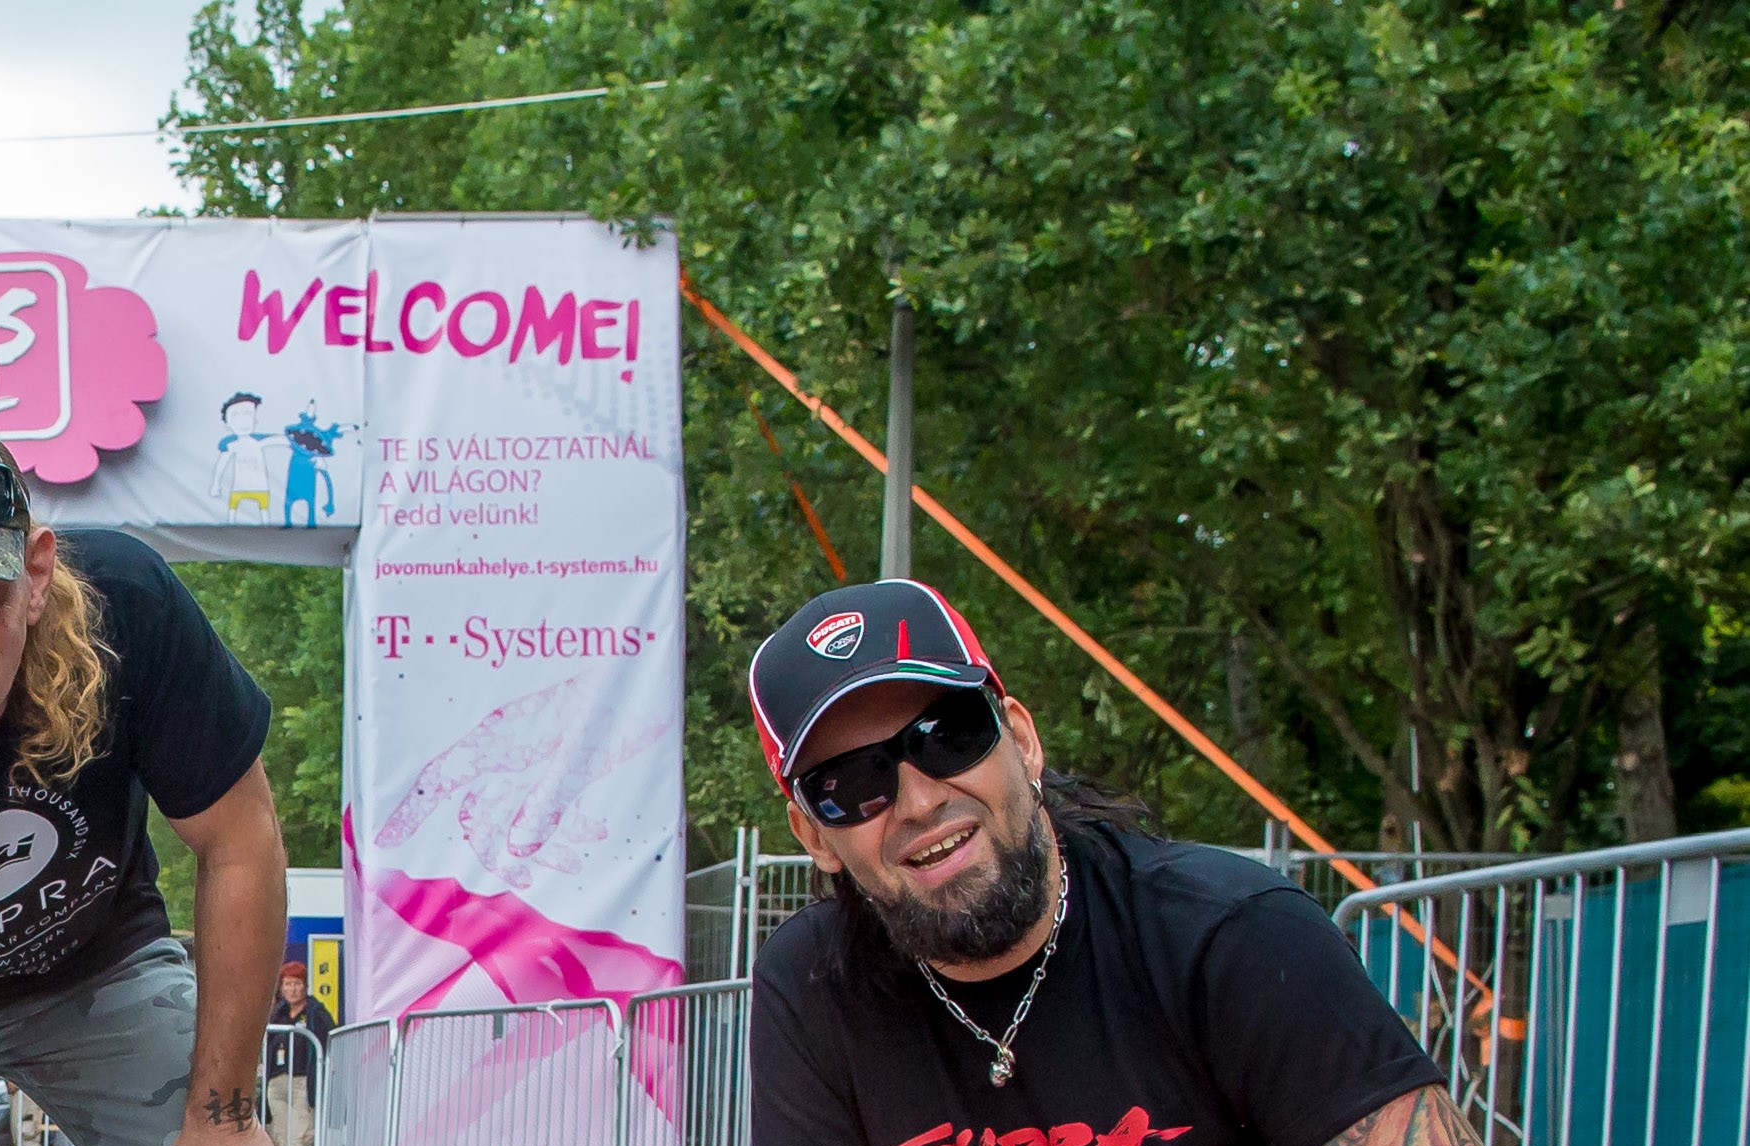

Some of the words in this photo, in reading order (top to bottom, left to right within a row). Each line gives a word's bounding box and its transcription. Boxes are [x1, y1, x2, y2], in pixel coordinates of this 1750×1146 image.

[238, 269, 640, 384] WELCOME!
[378, 438, 409, 462] TE
[418, 438, 440, 461] IS
[447, 435, 656, 461] VÁLTOZTATNÁL
[379, 471, 397, 494] A
[405, 467, 543, 494] VILÁGON?
[379, 503, 442, 526] Tedd
[449, 503, 539, 526] velünk!
[375, 557, 659, 580] jovomunkahelye.t-systems.hu
[812, 616, 856, 642] DUCATI
[827, 634, 856, 653] CORSE
[7, 785, 90, 837] THOUSAND
[24, 874, 117, 935] COMPANY
[18, 929, 65, 959] YORK
